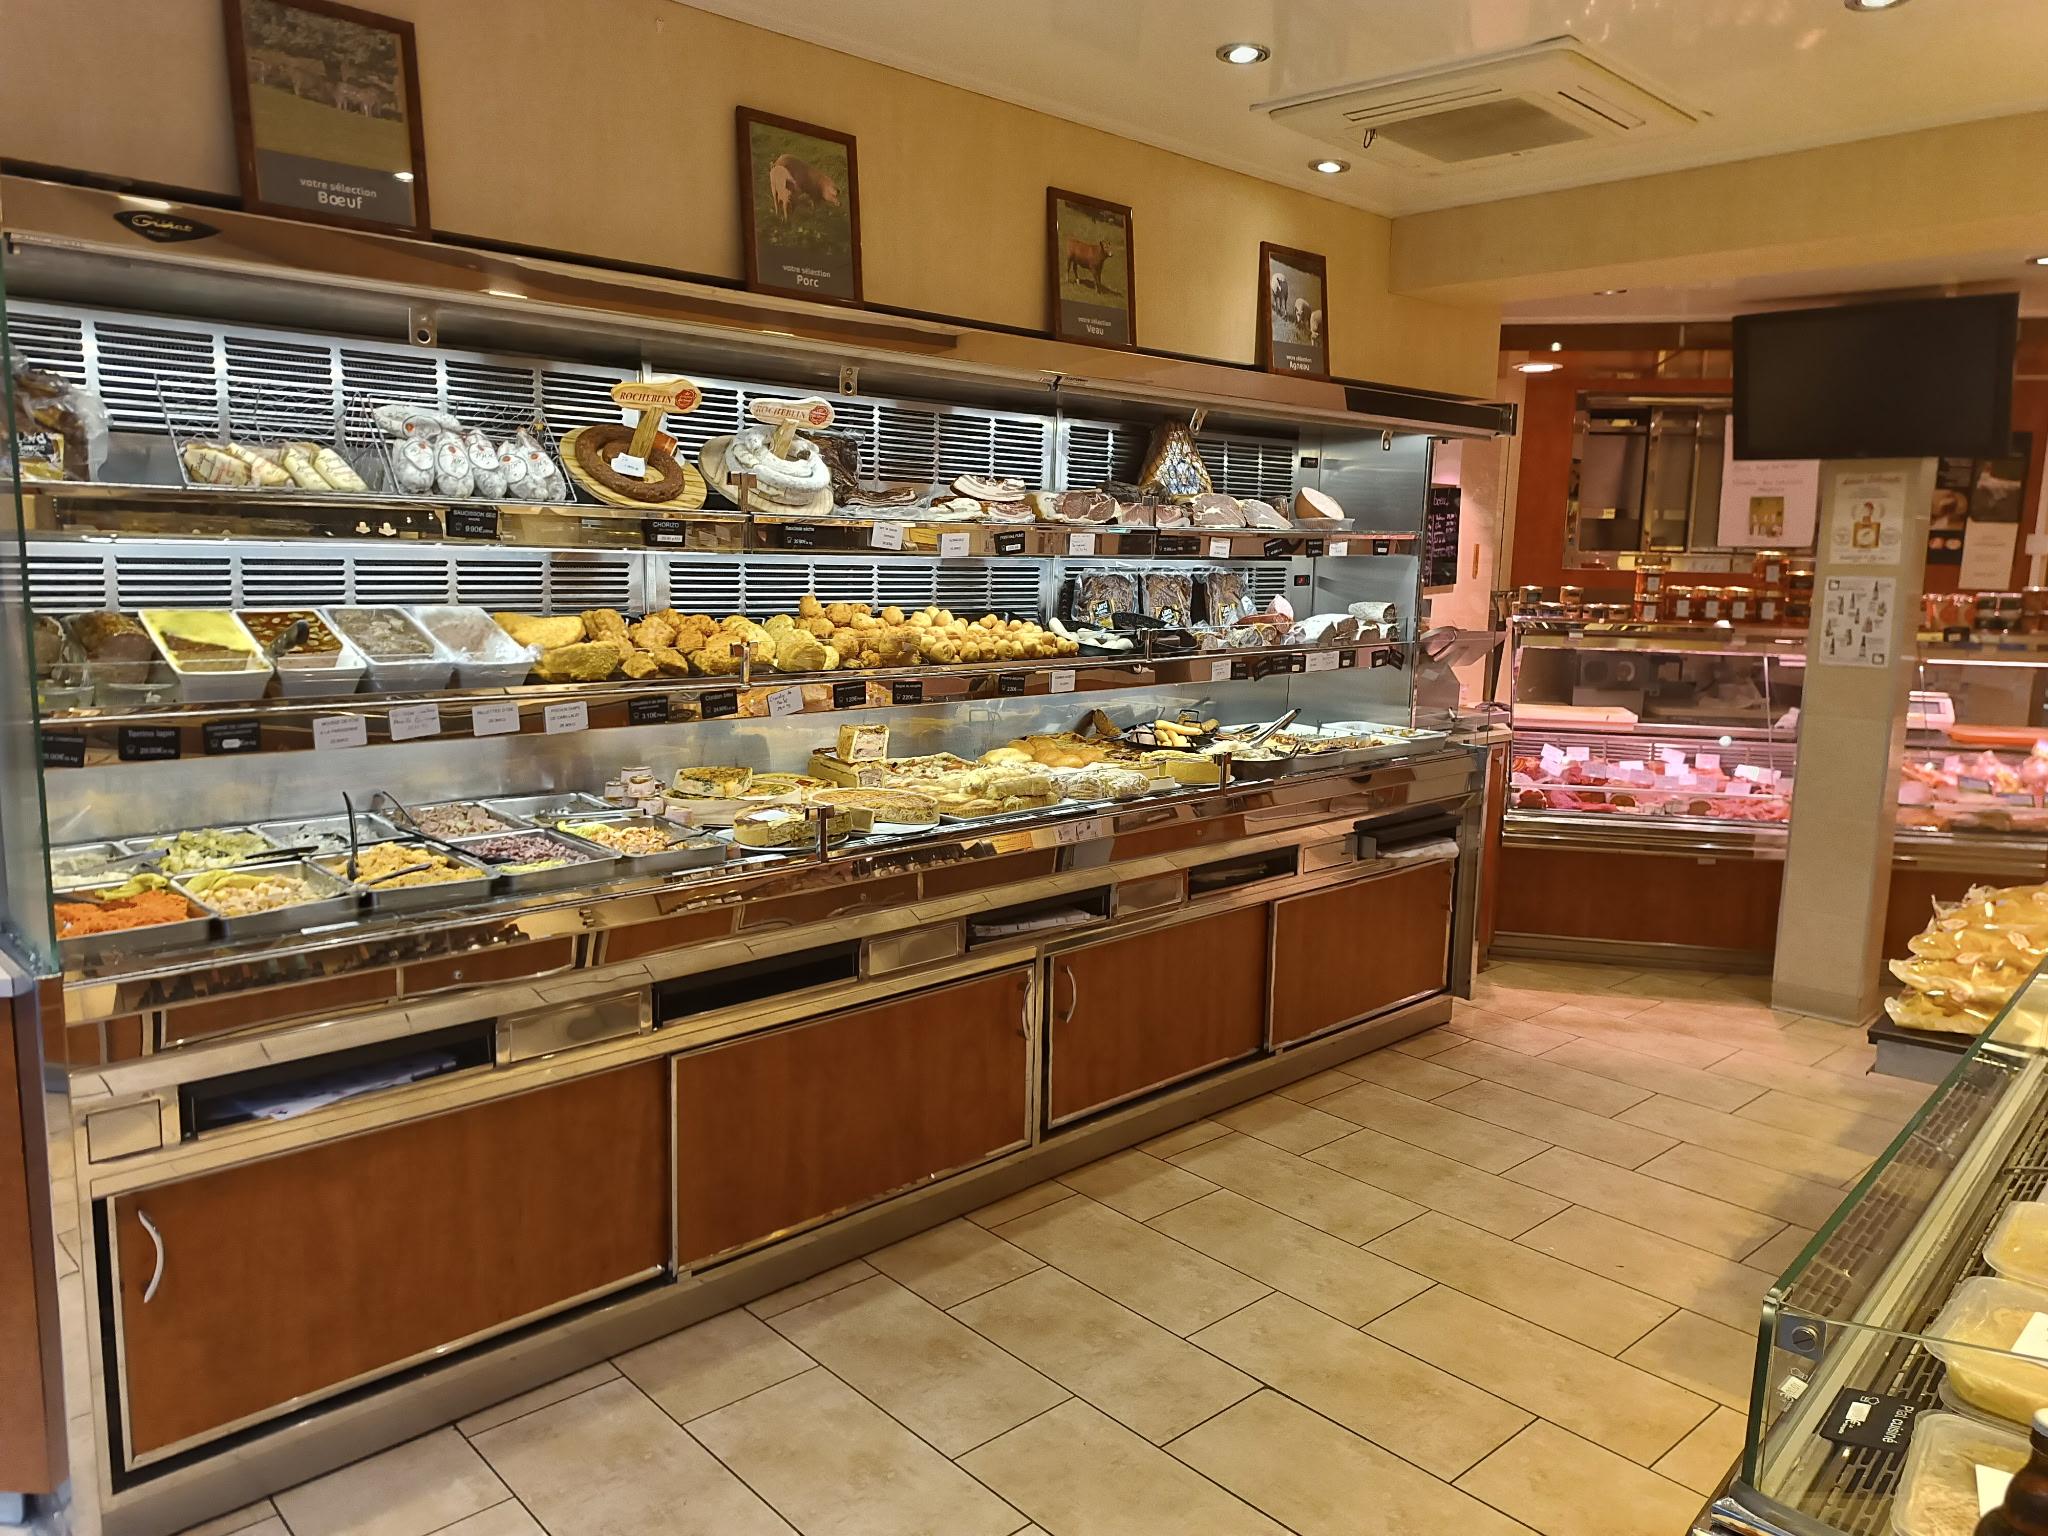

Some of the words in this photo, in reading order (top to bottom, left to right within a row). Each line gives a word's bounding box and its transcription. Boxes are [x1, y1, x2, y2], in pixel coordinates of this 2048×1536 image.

[300, 179, 328, 190] votre
[329, 183, 377, 198] sélection
[782, 265, 801, 273] votre
[801, 267, 831, 278] sélection
[796, 274, 820, 288] Porc
[1086, 324, 1104, 335] Veau
[1289, 360, 1310, 371] Agneau
[619, 391, 674, 404] ROCHEBLIN
[755, 404, 809, 419] ROCHEBLIN
[652, 521, 680, 529] CHORIZO
[1895, 1404, 1915, 1420] Plat
[1882, 1418, 1904, 1444] cuisiné
